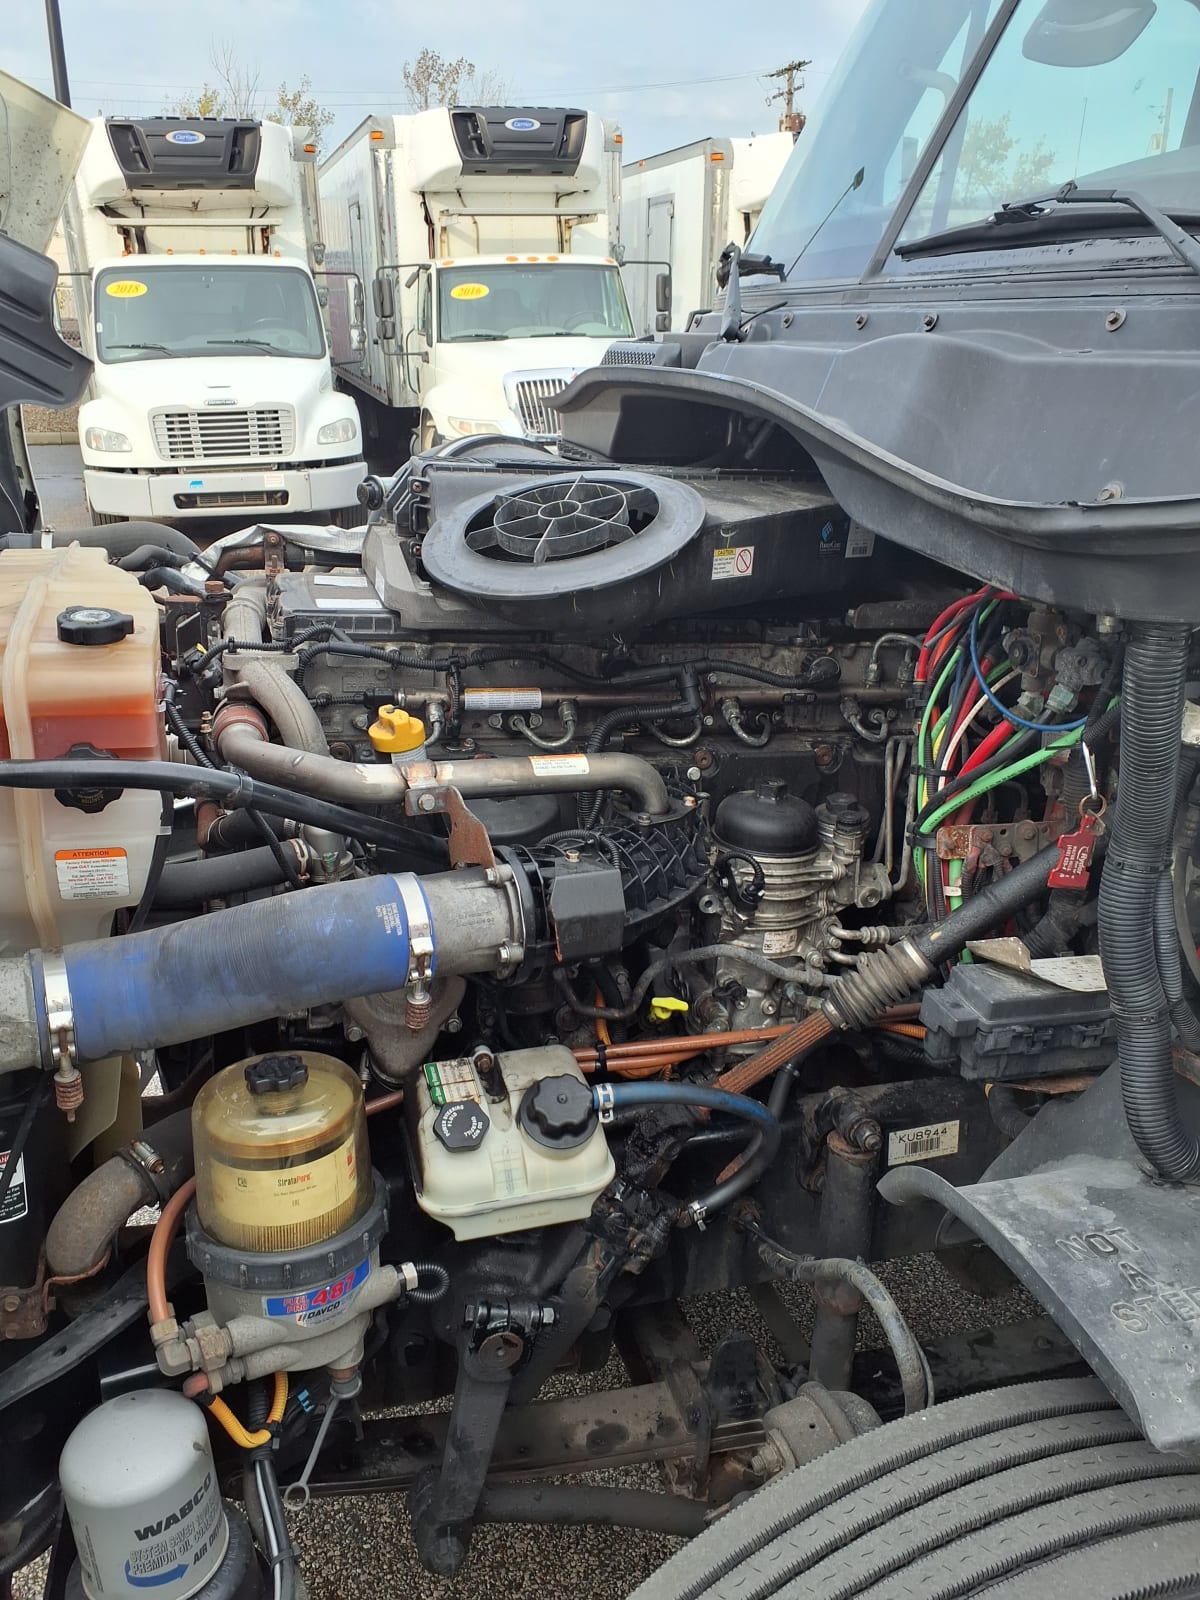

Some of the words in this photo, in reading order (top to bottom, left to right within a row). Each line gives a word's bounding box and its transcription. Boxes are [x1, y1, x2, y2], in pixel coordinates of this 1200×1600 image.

[443, 1104, 464, 1120] STEERING
[447, 1112, 459, 1127] FLUID
[442, 1121, 451, 1137] POWER
[464, 1116, 477, 1137] OVERFILL
[472, 1129, 480, 1139] NOT
[898, 1127, 948, 1144] KU8944
[277, 1173, 312, 1187] StrataPore
[1055, 1226, 1141, 1262] NOT
[1119, 1262, 1158, 1291] A
[311, 1271, 356, 1306] 487
[282, 1295, 309, 1307] FUEL
[287, 1304, 309, 1313] PRO
[306, 1301, 341, 1319] DAVCO
[134, 1472, 212, 1541] WABCO
[130, 1539, 169, 1562] SYSTEM
[169, 1520, 196, 1548] SAVER
[132, 1551, 178, 1575] PREMIUM
[193, 1545, 208, 1566] AIR
